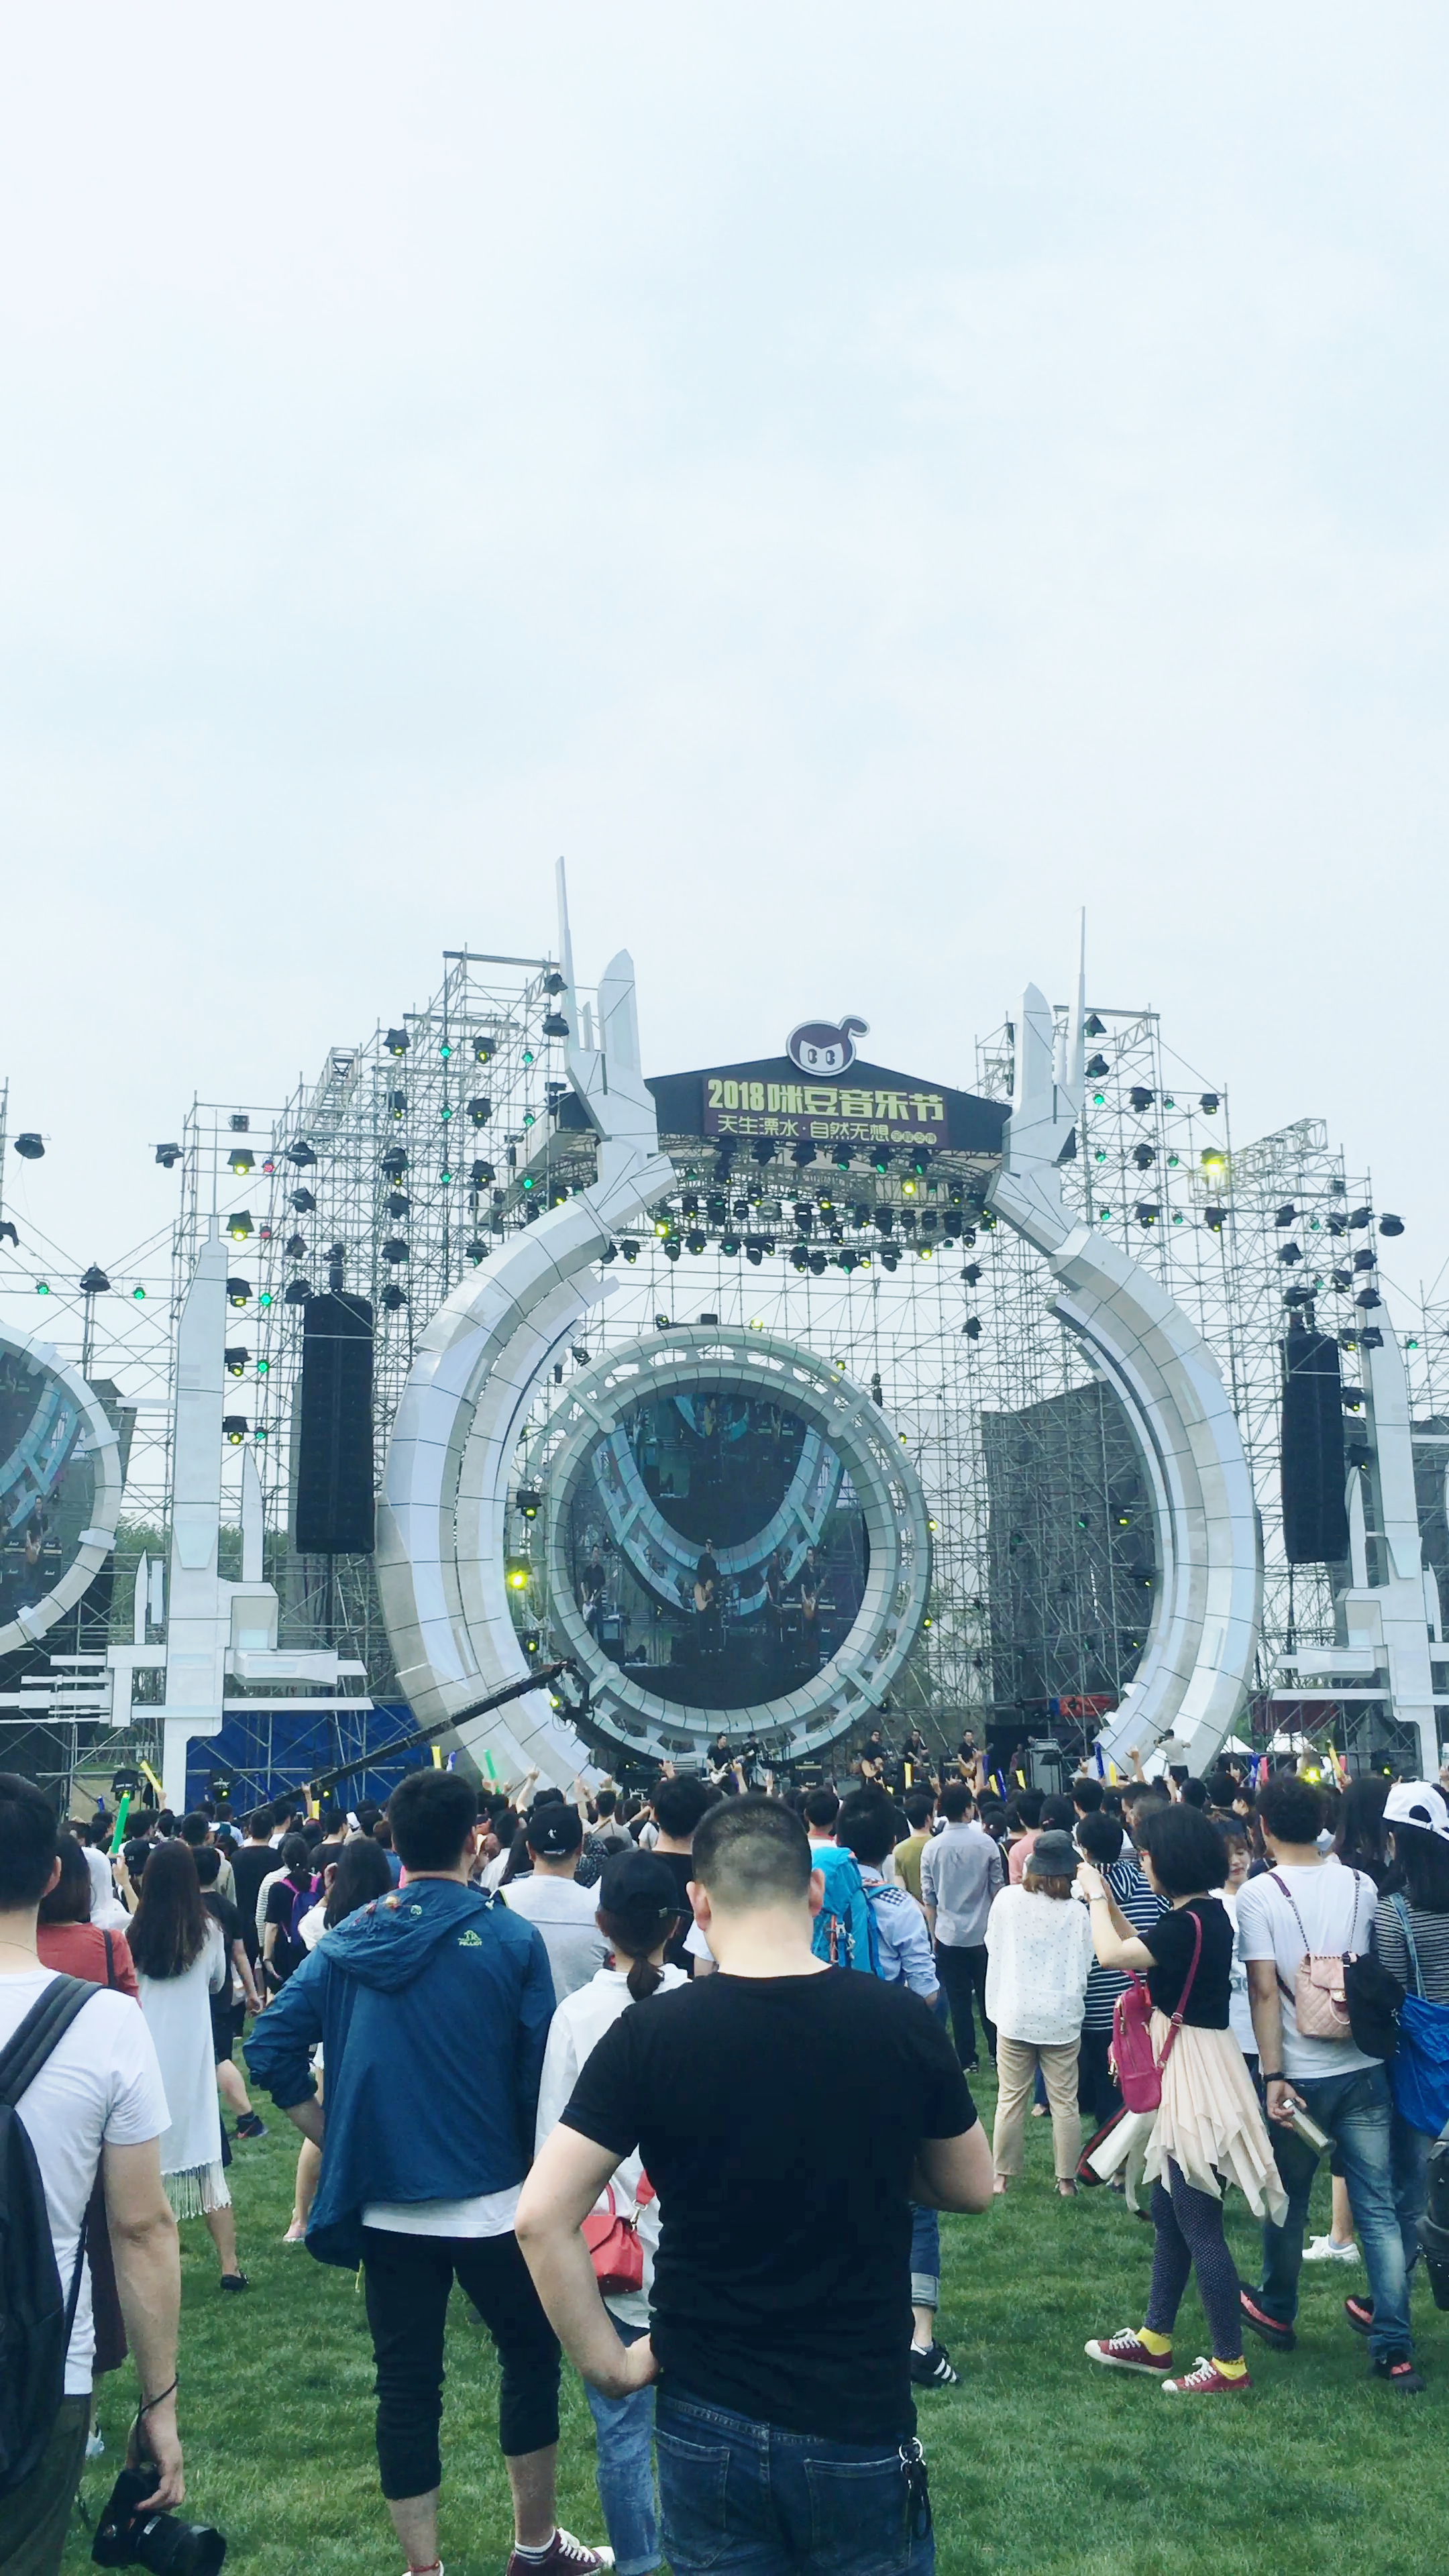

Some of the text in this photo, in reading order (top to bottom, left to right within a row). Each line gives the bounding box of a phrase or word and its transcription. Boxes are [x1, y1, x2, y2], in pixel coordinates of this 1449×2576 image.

[708, 1079, 944, 1122] 2018咪豆音乐节
